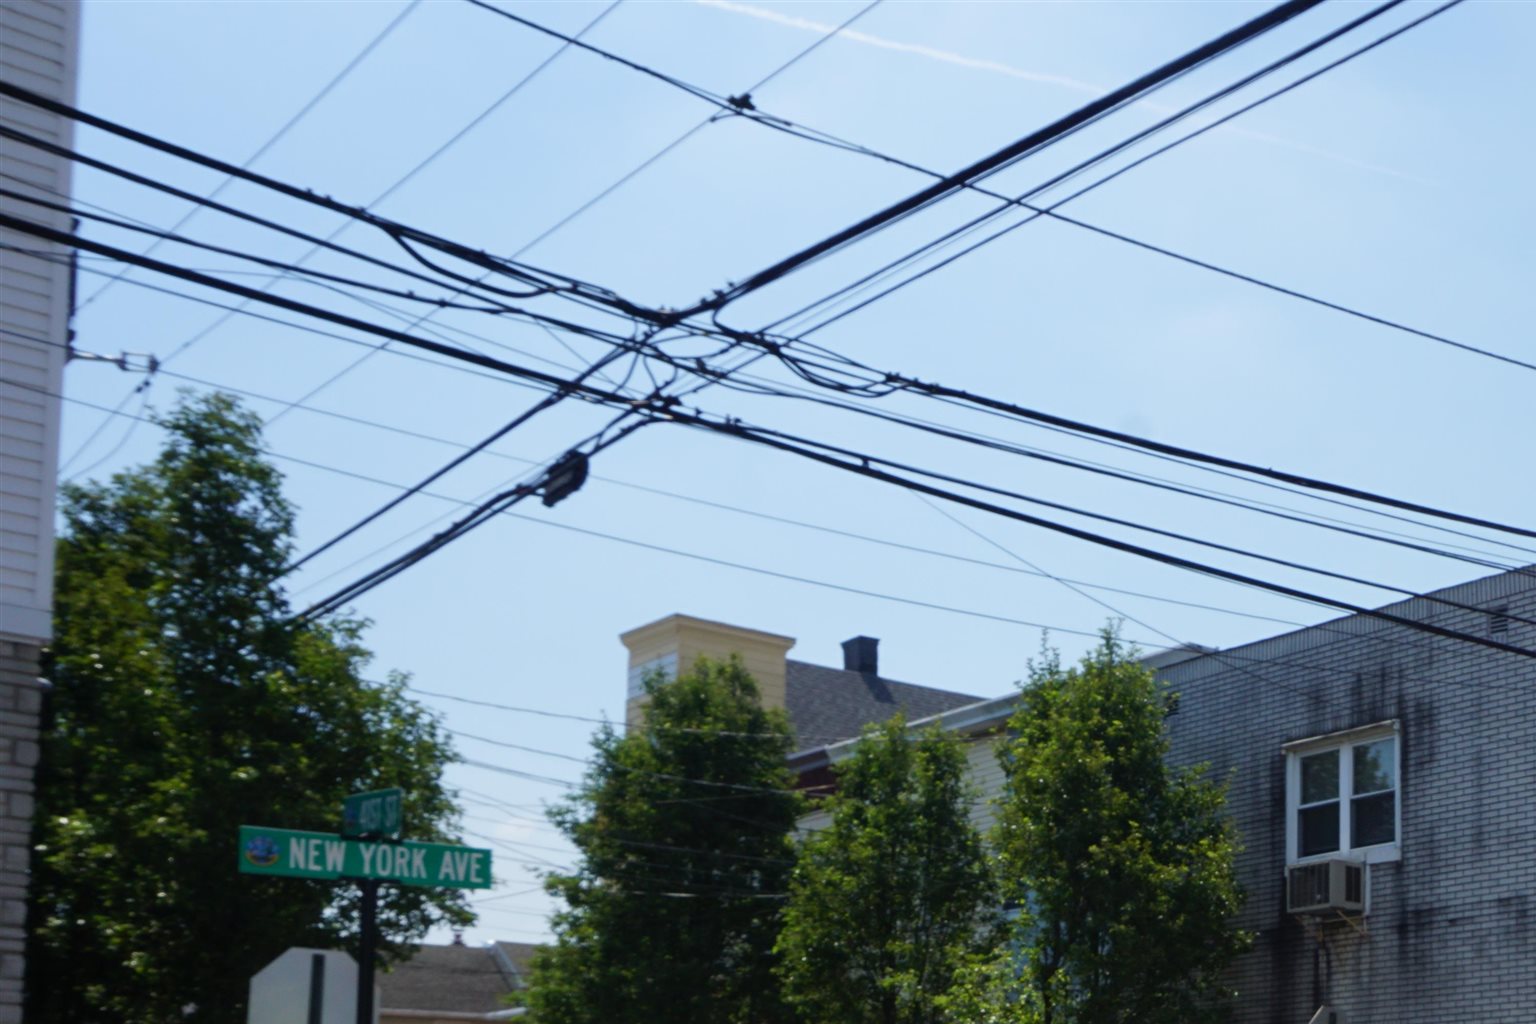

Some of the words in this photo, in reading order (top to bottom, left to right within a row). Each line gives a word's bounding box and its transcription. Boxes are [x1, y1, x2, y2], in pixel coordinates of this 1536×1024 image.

[289, 837, 347, 872] NEW
[359, 844, 427, 879] YORK
[438, 852, 484, 884] AVE
